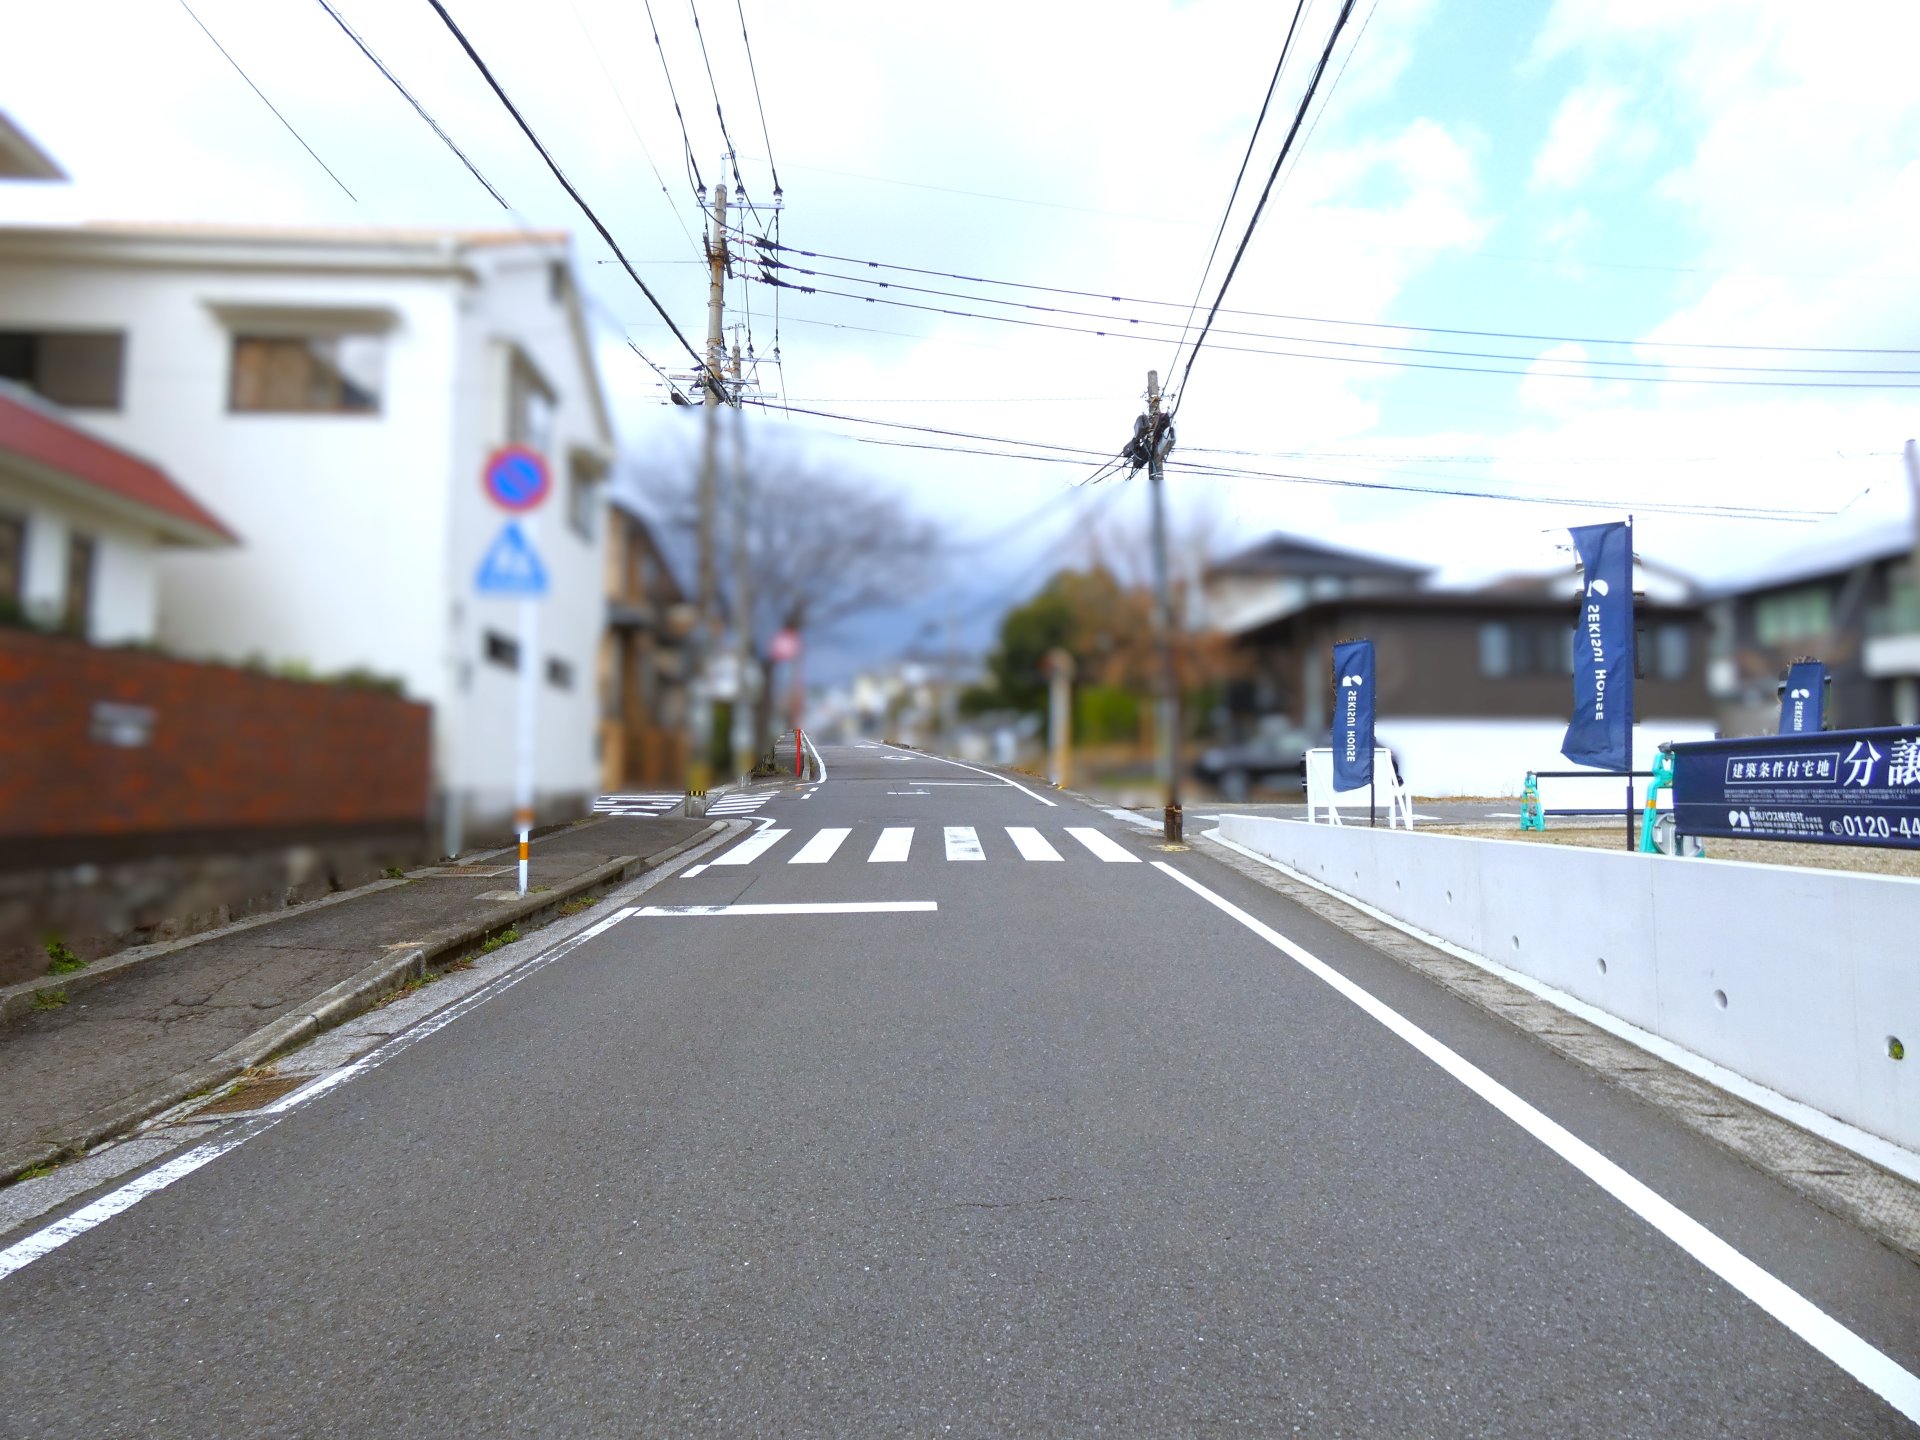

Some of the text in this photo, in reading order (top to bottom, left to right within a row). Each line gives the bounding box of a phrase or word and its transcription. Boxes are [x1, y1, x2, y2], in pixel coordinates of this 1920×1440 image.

[1732, 759, 1830, 779] 建築条件付宅地
